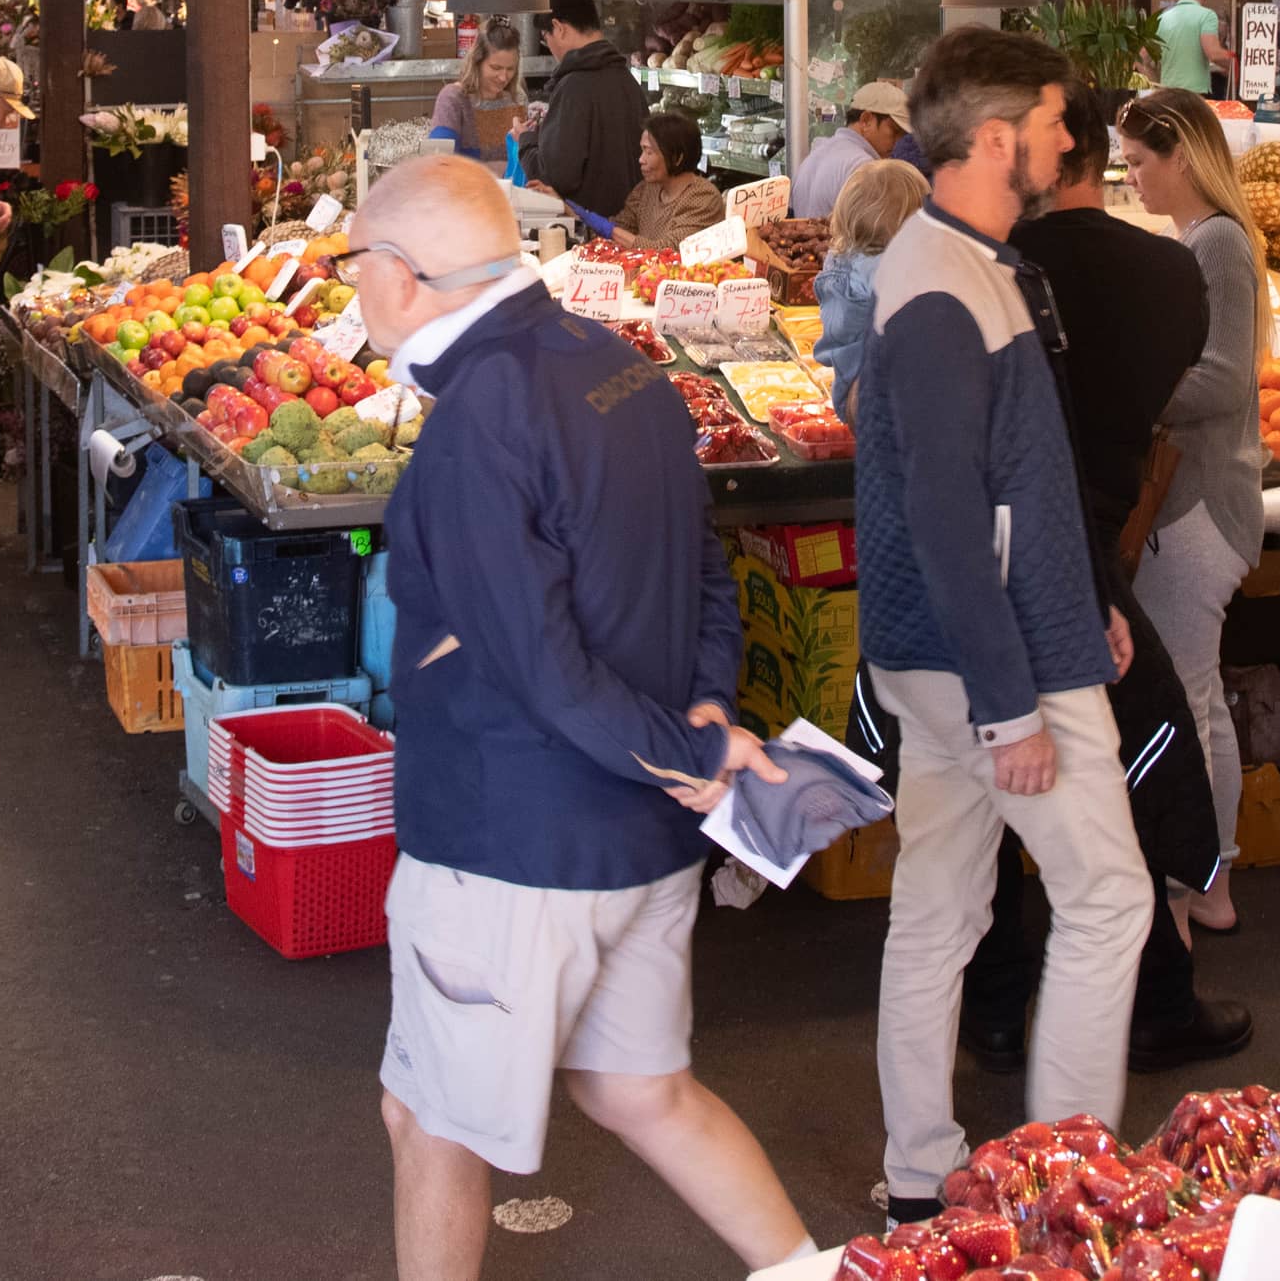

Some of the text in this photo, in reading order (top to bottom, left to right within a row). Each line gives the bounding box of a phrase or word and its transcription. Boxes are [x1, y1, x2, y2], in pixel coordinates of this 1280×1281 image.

[1247, 5, 1277, 17] PLEASE
[1246, 21, 1275, 43] PAY
[1245, 48, 1275, 66] HERE
[664, 283, 717, 298] Blueberries
